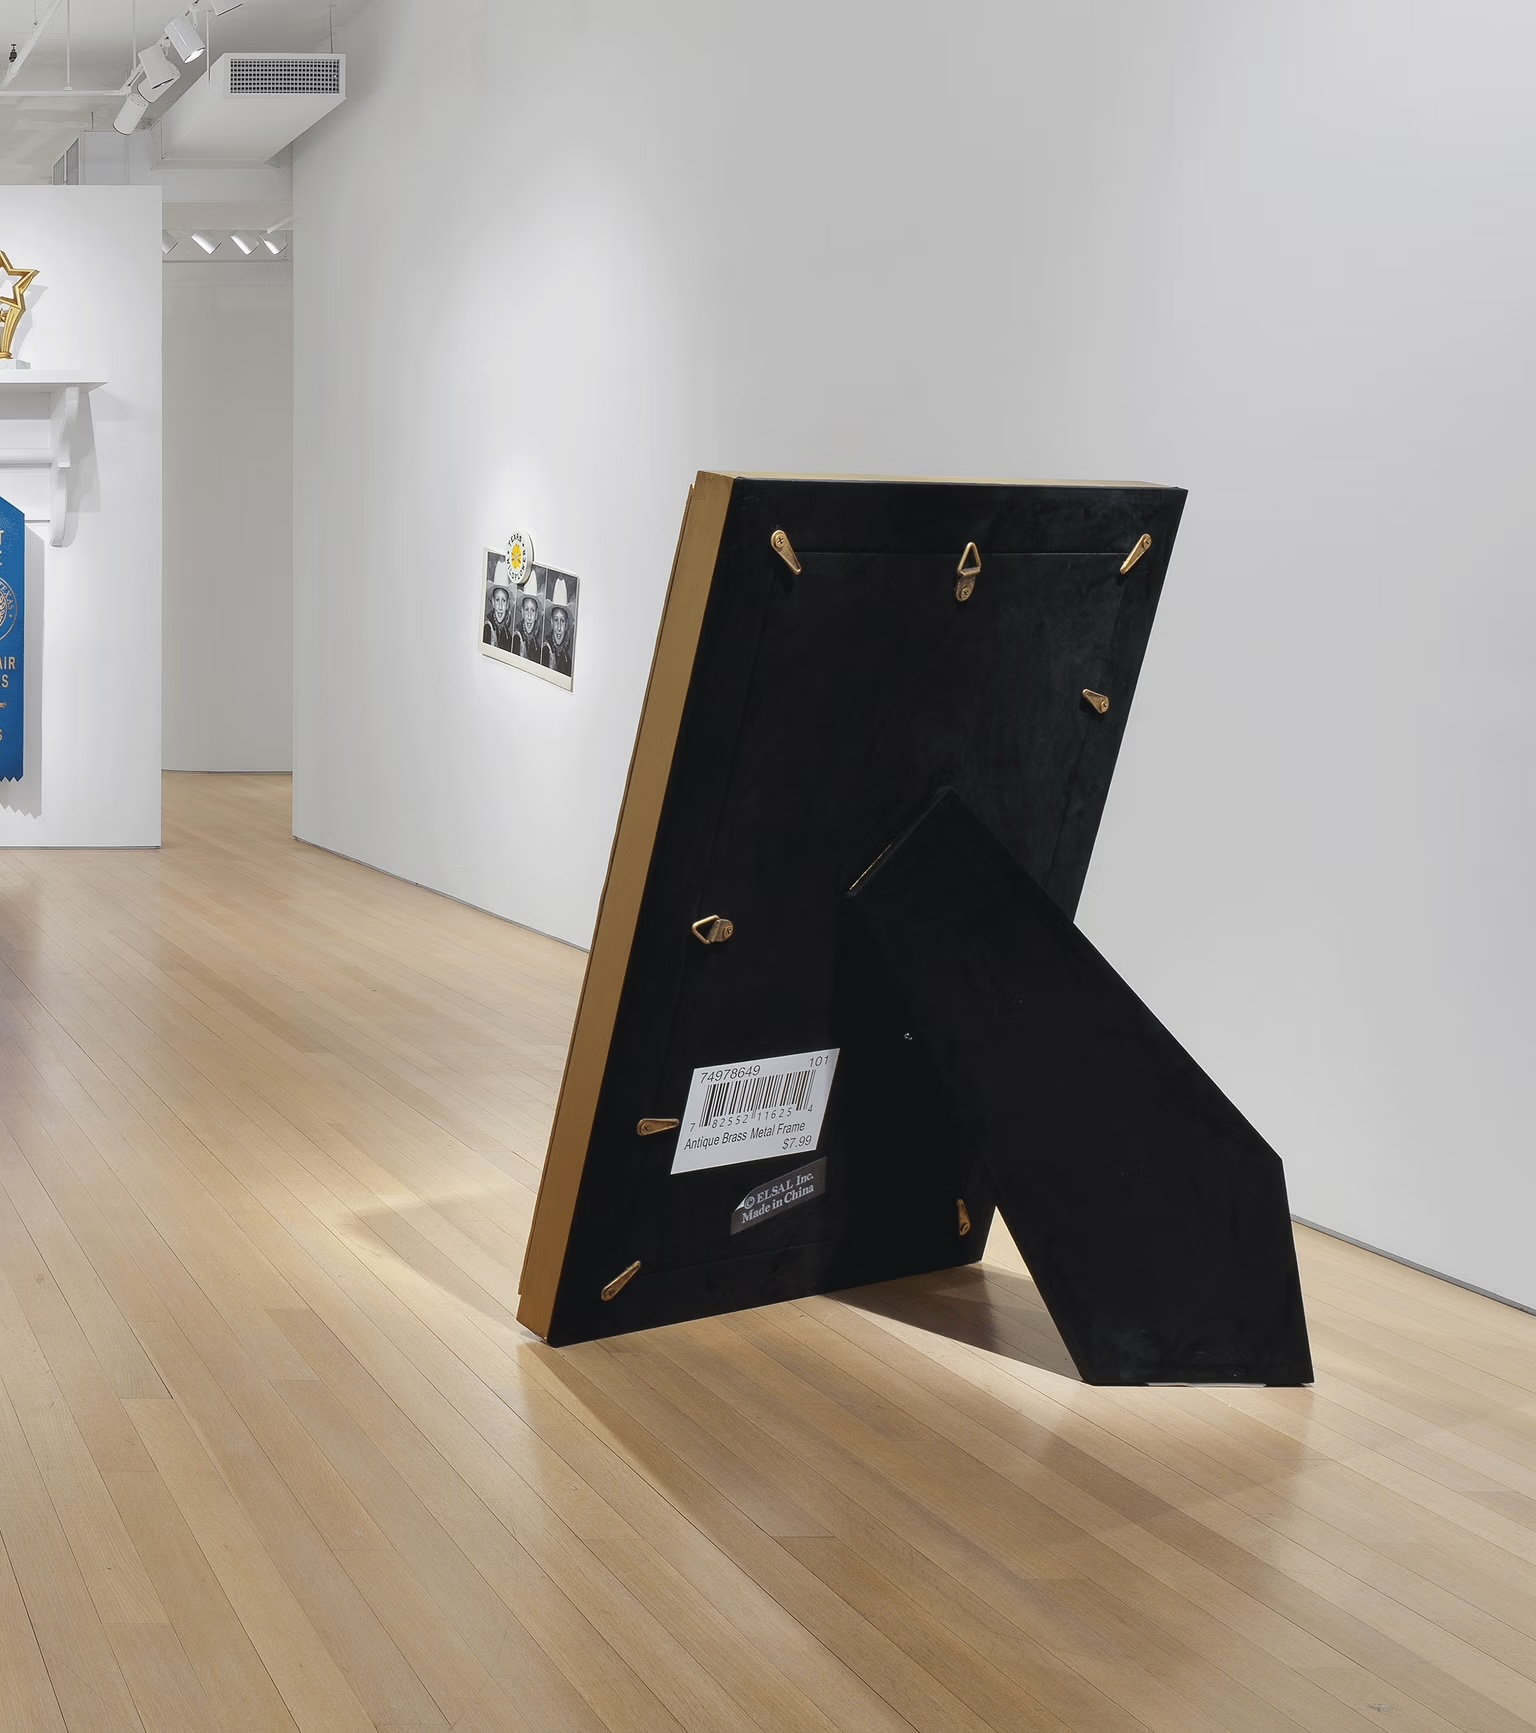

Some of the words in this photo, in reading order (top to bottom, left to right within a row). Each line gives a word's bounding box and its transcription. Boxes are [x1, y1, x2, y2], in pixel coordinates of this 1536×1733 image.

[508, 533, 522, 547] TEXAS
[700, 1065, 761, 1084] 74978649
[809, 1056, 829, 1068] 101
[690, 1123, 696, 1132] 7
[712, 1115, 749, 1128] 82552
[757, 1108, 793, 1121] 11625
[807, 1104, 813, 1113] 4
[684, 1134, 720, 1150] Antique
[722, 1130, 748, 1144] Brass
[750, 1125, 775, 1140] Metal
[777, 1121, 806, 1135] Frame
[782, 1135, 812, 1150] $7.99
[756, 1180, 793, 1204] ELSAL
[796, 1171, 814, 1184] Inc.
[742, 1202, 771, 1224] Made
[772, 1198, 783, 1210] in
[784, 1184, 814, 1204] China
